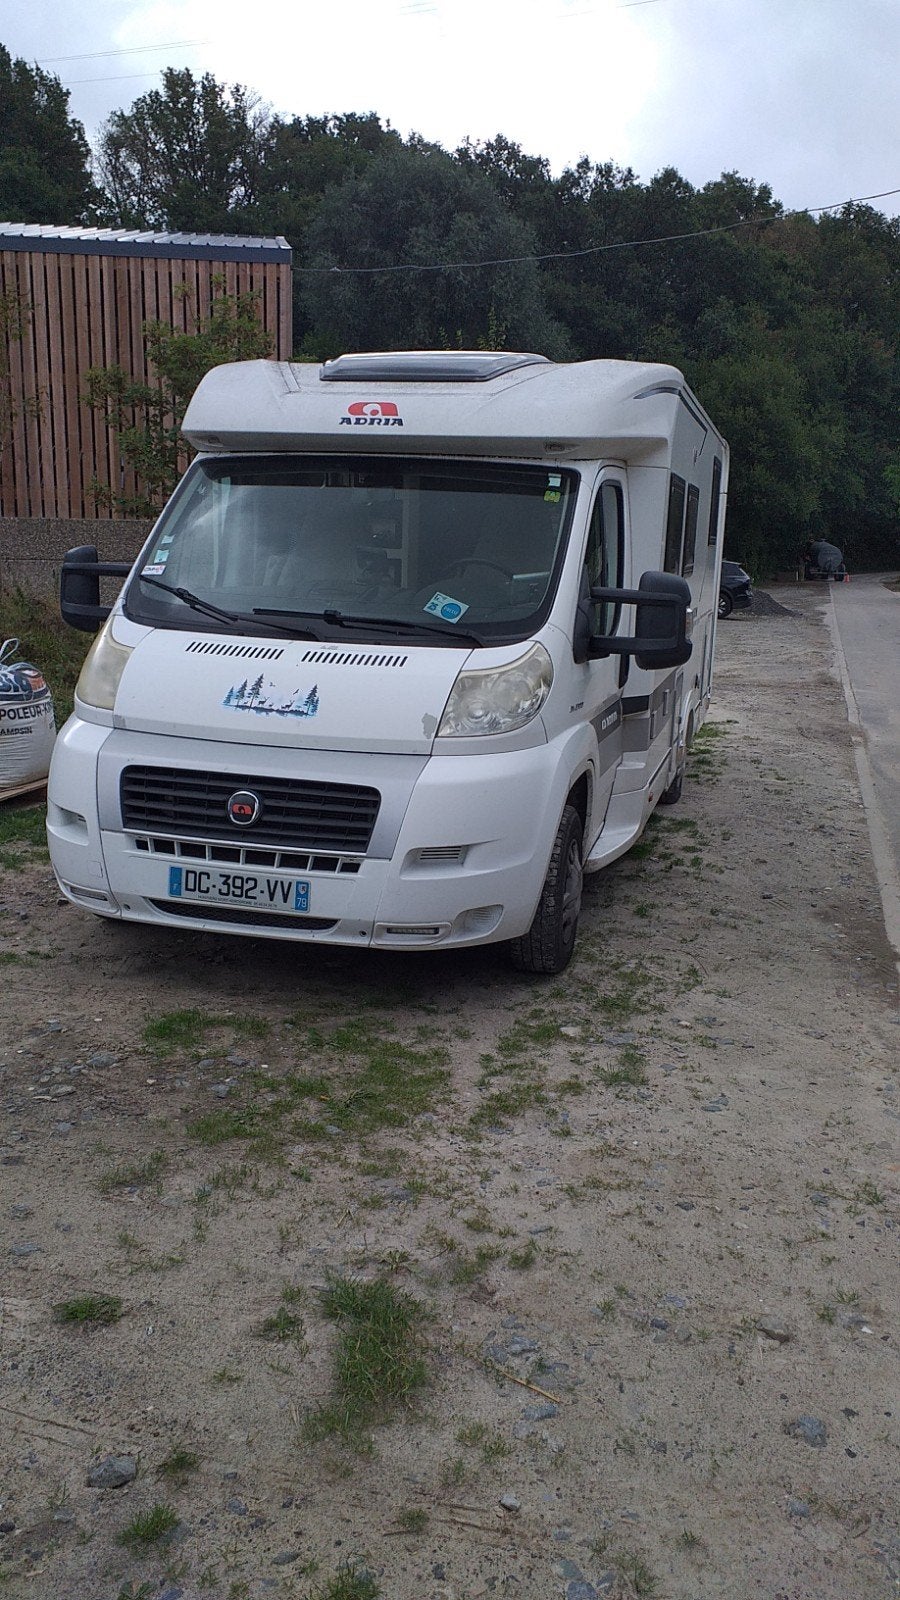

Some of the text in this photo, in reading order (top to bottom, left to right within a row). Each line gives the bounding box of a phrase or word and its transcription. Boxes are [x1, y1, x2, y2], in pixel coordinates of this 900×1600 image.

[339, 417, 404, 426] ADRIA
[185, 870, 292, 903] DC-392-VV
[297, 897, 307, 908] 79
